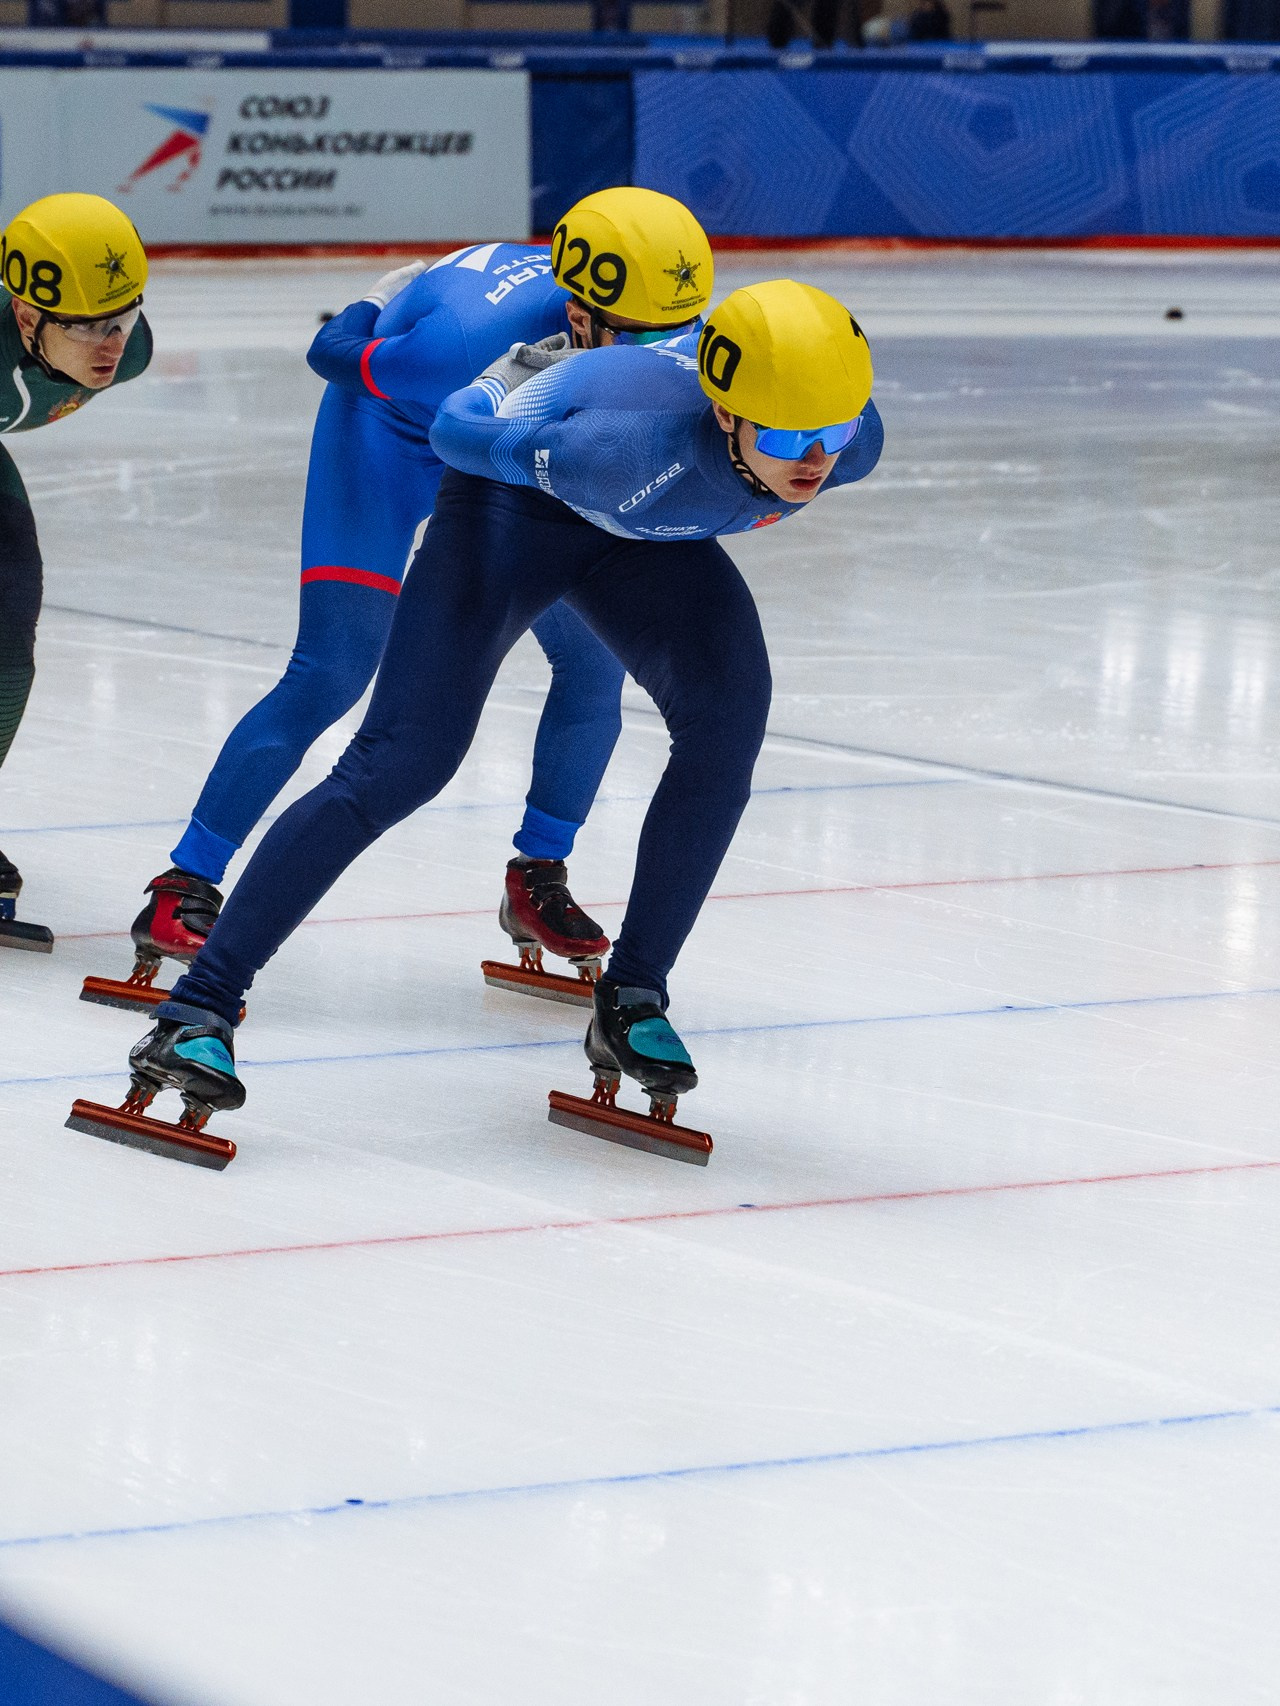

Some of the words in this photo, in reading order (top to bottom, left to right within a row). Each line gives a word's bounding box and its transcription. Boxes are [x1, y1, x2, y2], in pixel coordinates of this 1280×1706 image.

[239, 94, 331, 121] СОЮЗ
[227, 130, 473, 159] КОНЬКОБЕЖЦЕВ
[216, 166, 339, 192] РОССИИ
[550, 223, 627, 307] 029
[618, 462, 685, 513] corsa
